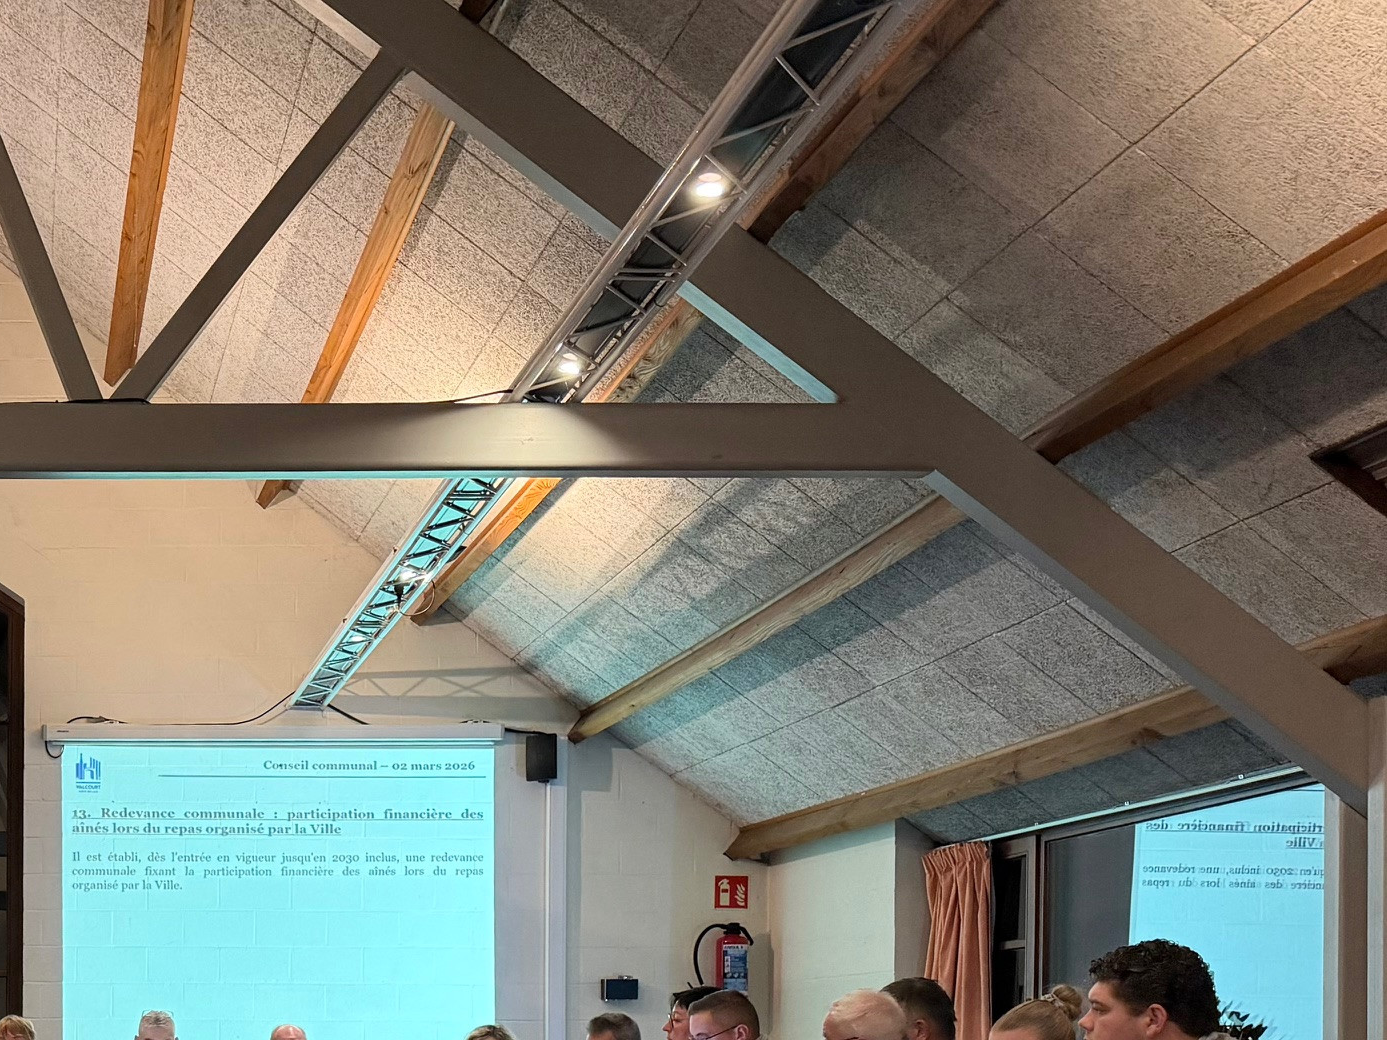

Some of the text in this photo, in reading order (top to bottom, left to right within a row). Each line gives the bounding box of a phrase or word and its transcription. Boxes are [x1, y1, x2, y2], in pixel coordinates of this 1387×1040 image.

[263, 760, 308, 770] Conseil
[312, 760, 377, 770] communal
[392, 762, 407, 770] 02
[411, 762, 442, 770] mars
[445, 761, 475, 771] 2026
[72, 809, 91, 820] 13.
[101, 807, 175, 819] Redevance
[184, 808, 265, 819] communale
[287, 808, 375, 821] participation
[384, 808, 452, 819] financière
[461, 808, 484, 819] des
[72, 823, 341, 836] aînés lors du repas organisé par la Ville
[72, 852, 484, 864] Il est établi, dès l'entrée en vigueur jusqu'en 2030 inclus, une redevance
[72, 866, 484, 878] communale fixant la participation financière des aînés lors du repas
[72, 880, 183, 892] organisé par la Ville.
